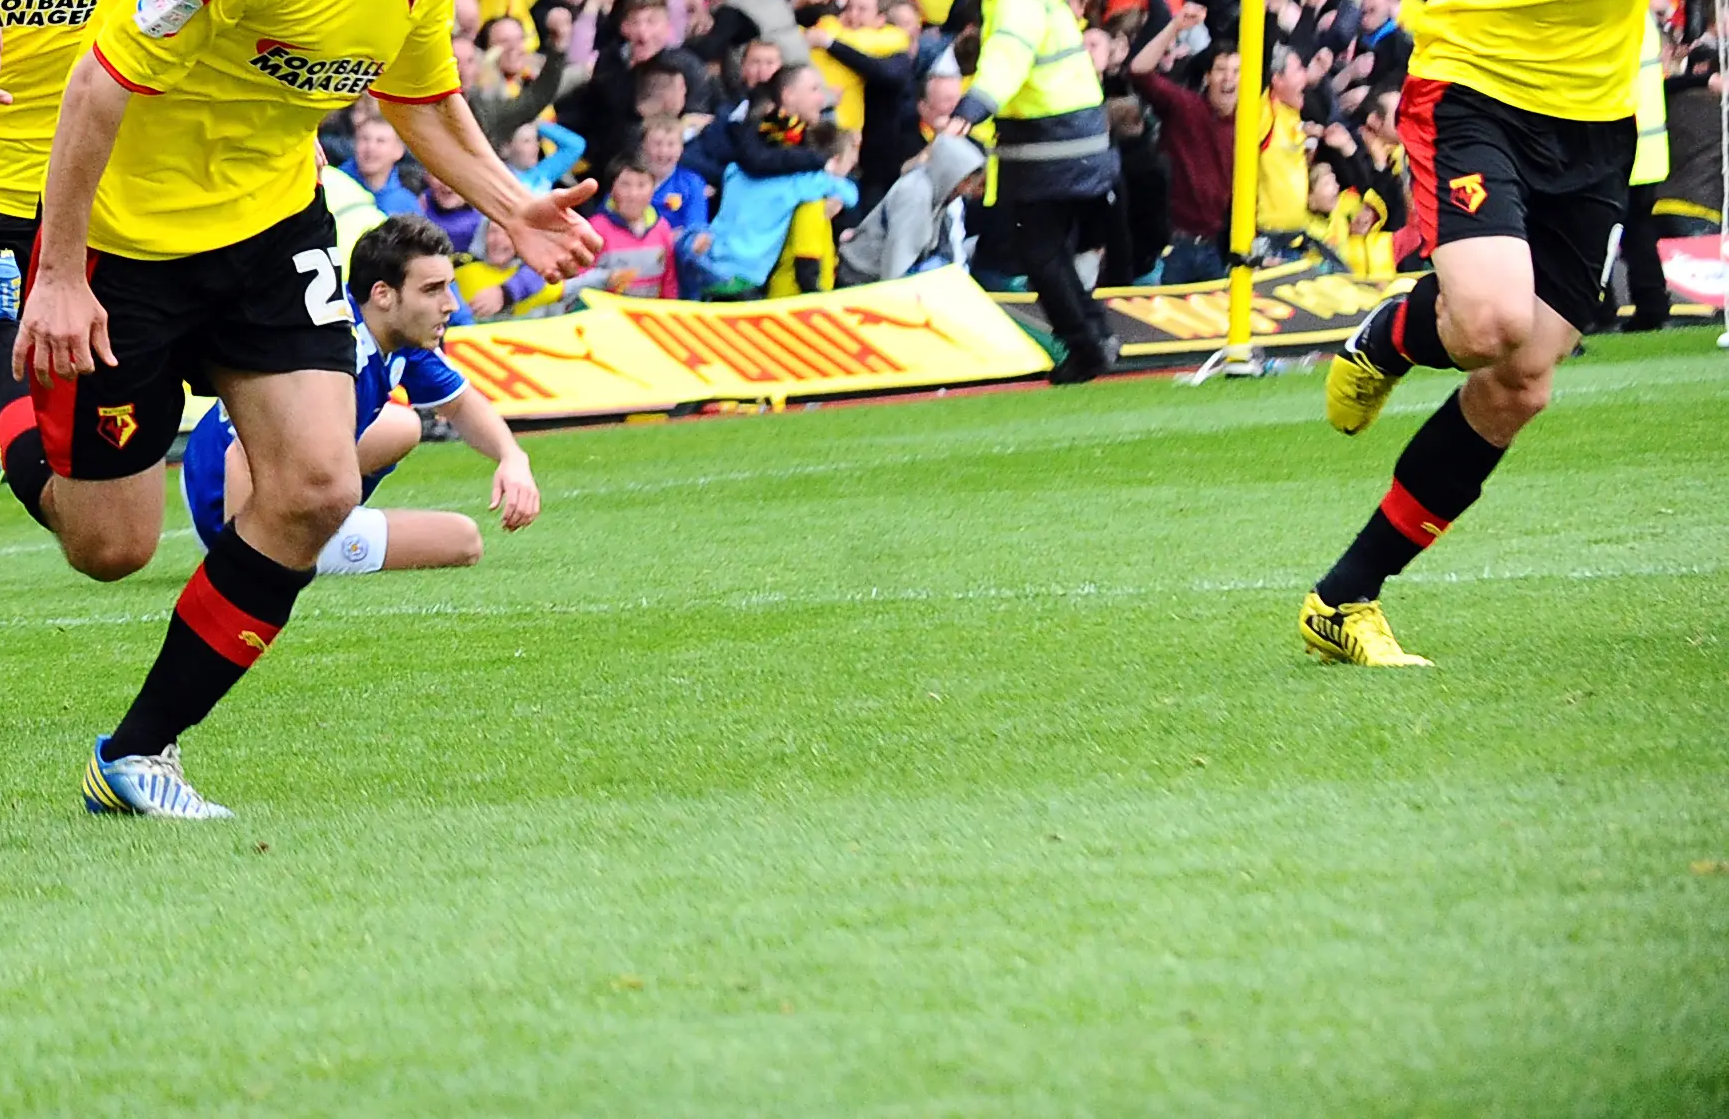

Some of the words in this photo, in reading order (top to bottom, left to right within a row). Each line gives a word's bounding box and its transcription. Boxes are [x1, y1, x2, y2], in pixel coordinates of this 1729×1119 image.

[266, 45, 385, 77] FOOTBALL
[292, 246, 356, 327] 2
[622, 307, 908, 385] PUMA
